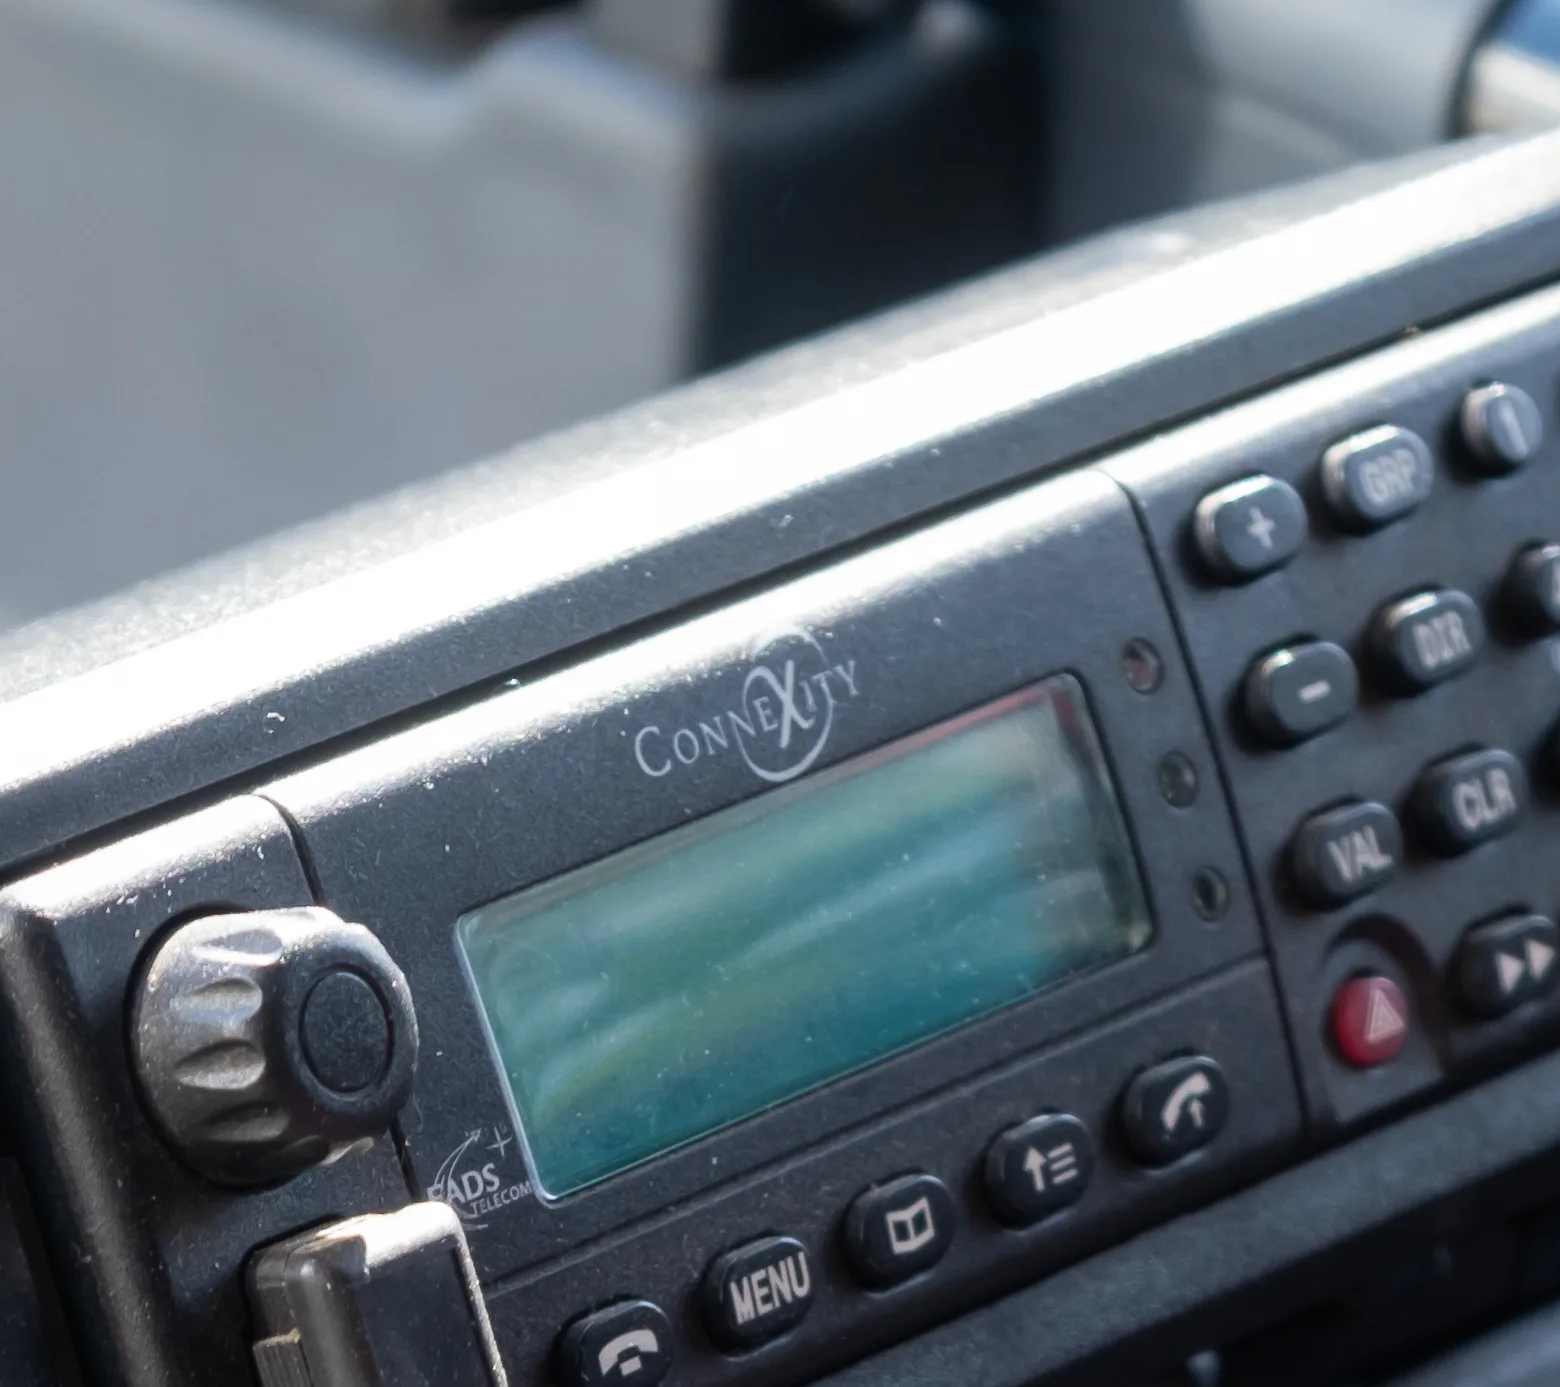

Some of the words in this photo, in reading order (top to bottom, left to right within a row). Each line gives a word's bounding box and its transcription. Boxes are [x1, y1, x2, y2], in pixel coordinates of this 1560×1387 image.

[1358, 448, 1417, 504] GRP
[1496, 396, 1530, 460] 1
[1412, 611, 1472, 670] DIR
[1326, 824, 1394, 883] VAL
[1452, 767, 1517, 832] CLR
[469, 1180, 534, 1218] TELECOM
[729, 1250, 811, 1326] MENU
